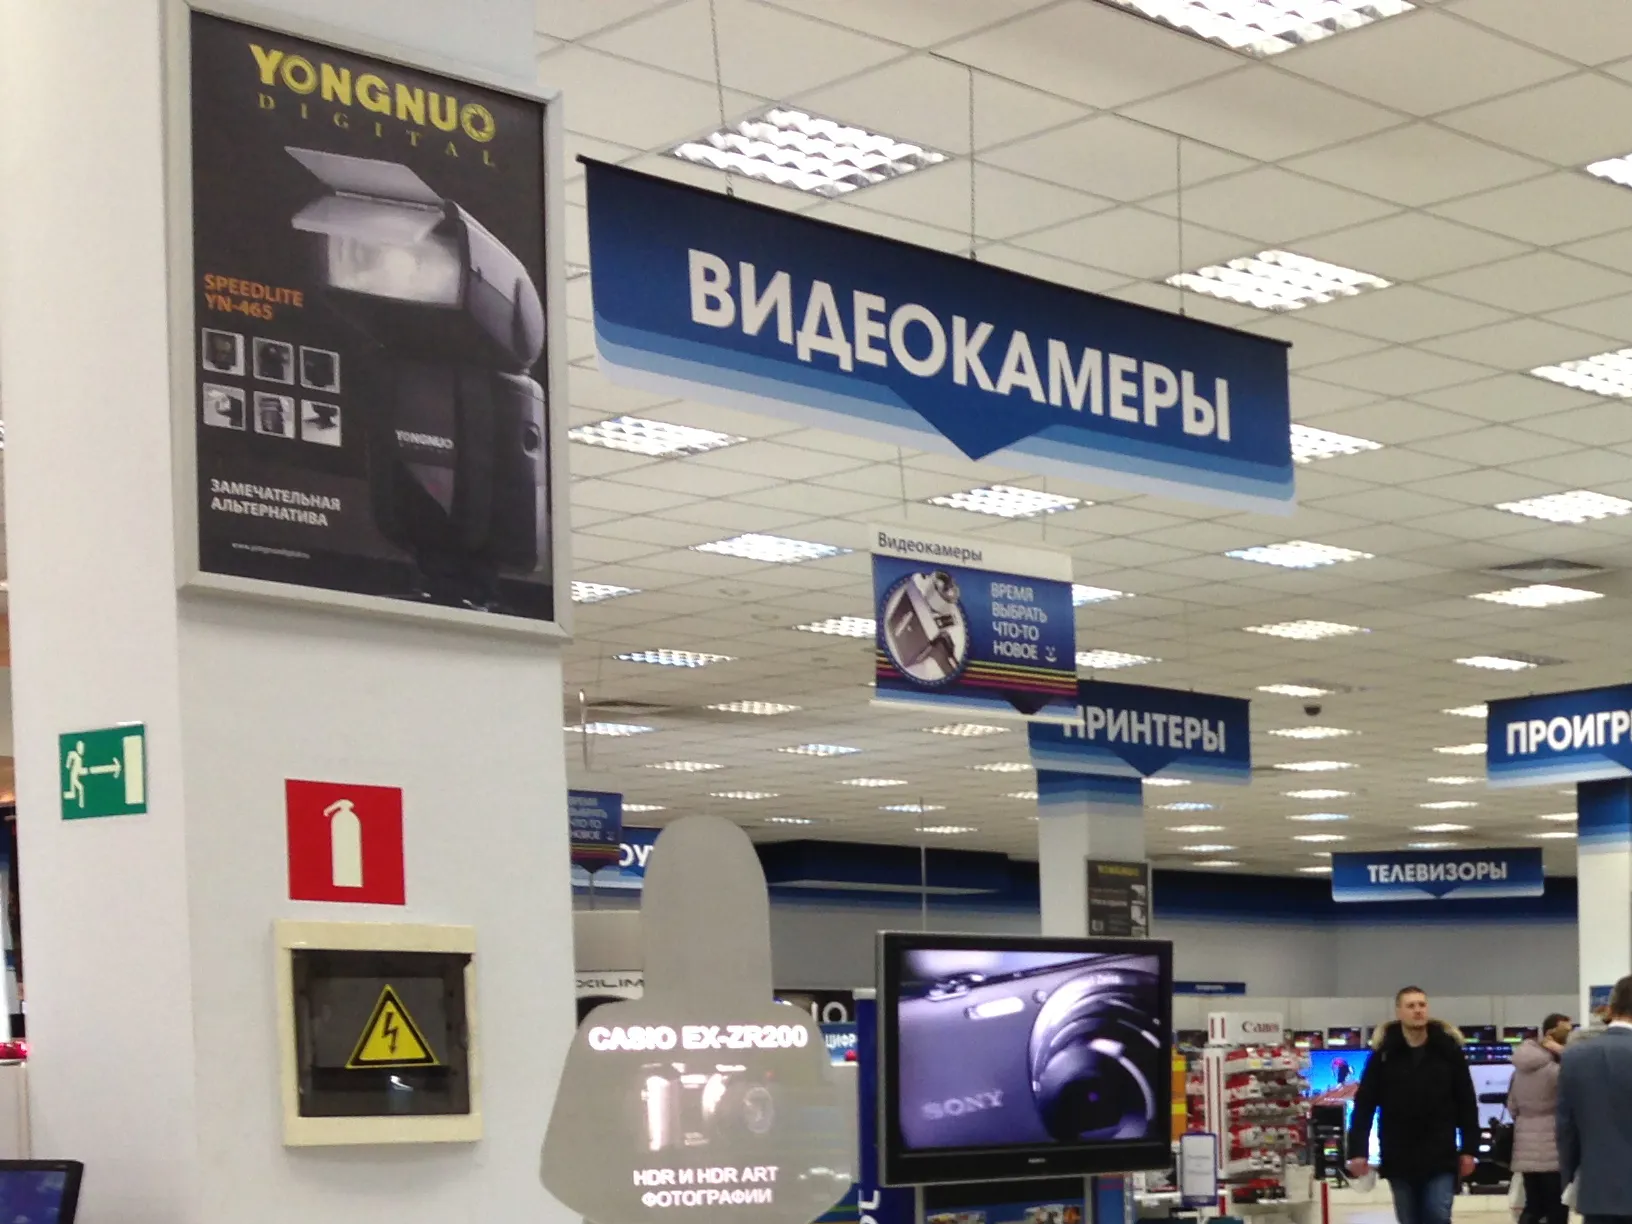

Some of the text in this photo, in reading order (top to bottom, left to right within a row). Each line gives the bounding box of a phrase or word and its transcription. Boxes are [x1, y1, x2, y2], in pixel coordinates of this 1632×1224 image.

[249, 44, 495, 143] YONGNUO
[204, 273, 303, 307] SPEEDLITE
[205, 294, 273, 321] YN-465
[687, 248, 1231, 442] ВИДЕОКАМЕРЫ
[210, 478, 341, 511] ЗАМЕЧАТЕЛЬНАЯ
[210, 498, 328, 527] АЛЬТЕРНАТИВА
[877, 532, 982, 563] Видеокамеры
[990, 582, 1033, 602] ВРЕМЯ
[991, 602, 1048, 624] ВЫБРАТЬ
[992, 621, 1040, 641] ЧТО-ТО
[993, 640, 1039, 661] НОВОЕ
[1367, 861, 1508, 883] ТЕЛЕВИЗОРЫ
[588, 1025, 809, 1051] CASIO EX-ZR200
[920, 1089, 1004, 1121] SONY
[633, 1169, 676, 1187] HDR
[697, 1167, 739, 1185] HDR
[741, 1166, 779, 1182] ART
[641, 1188, 773, 1208] ФОТОГРАФИИ
